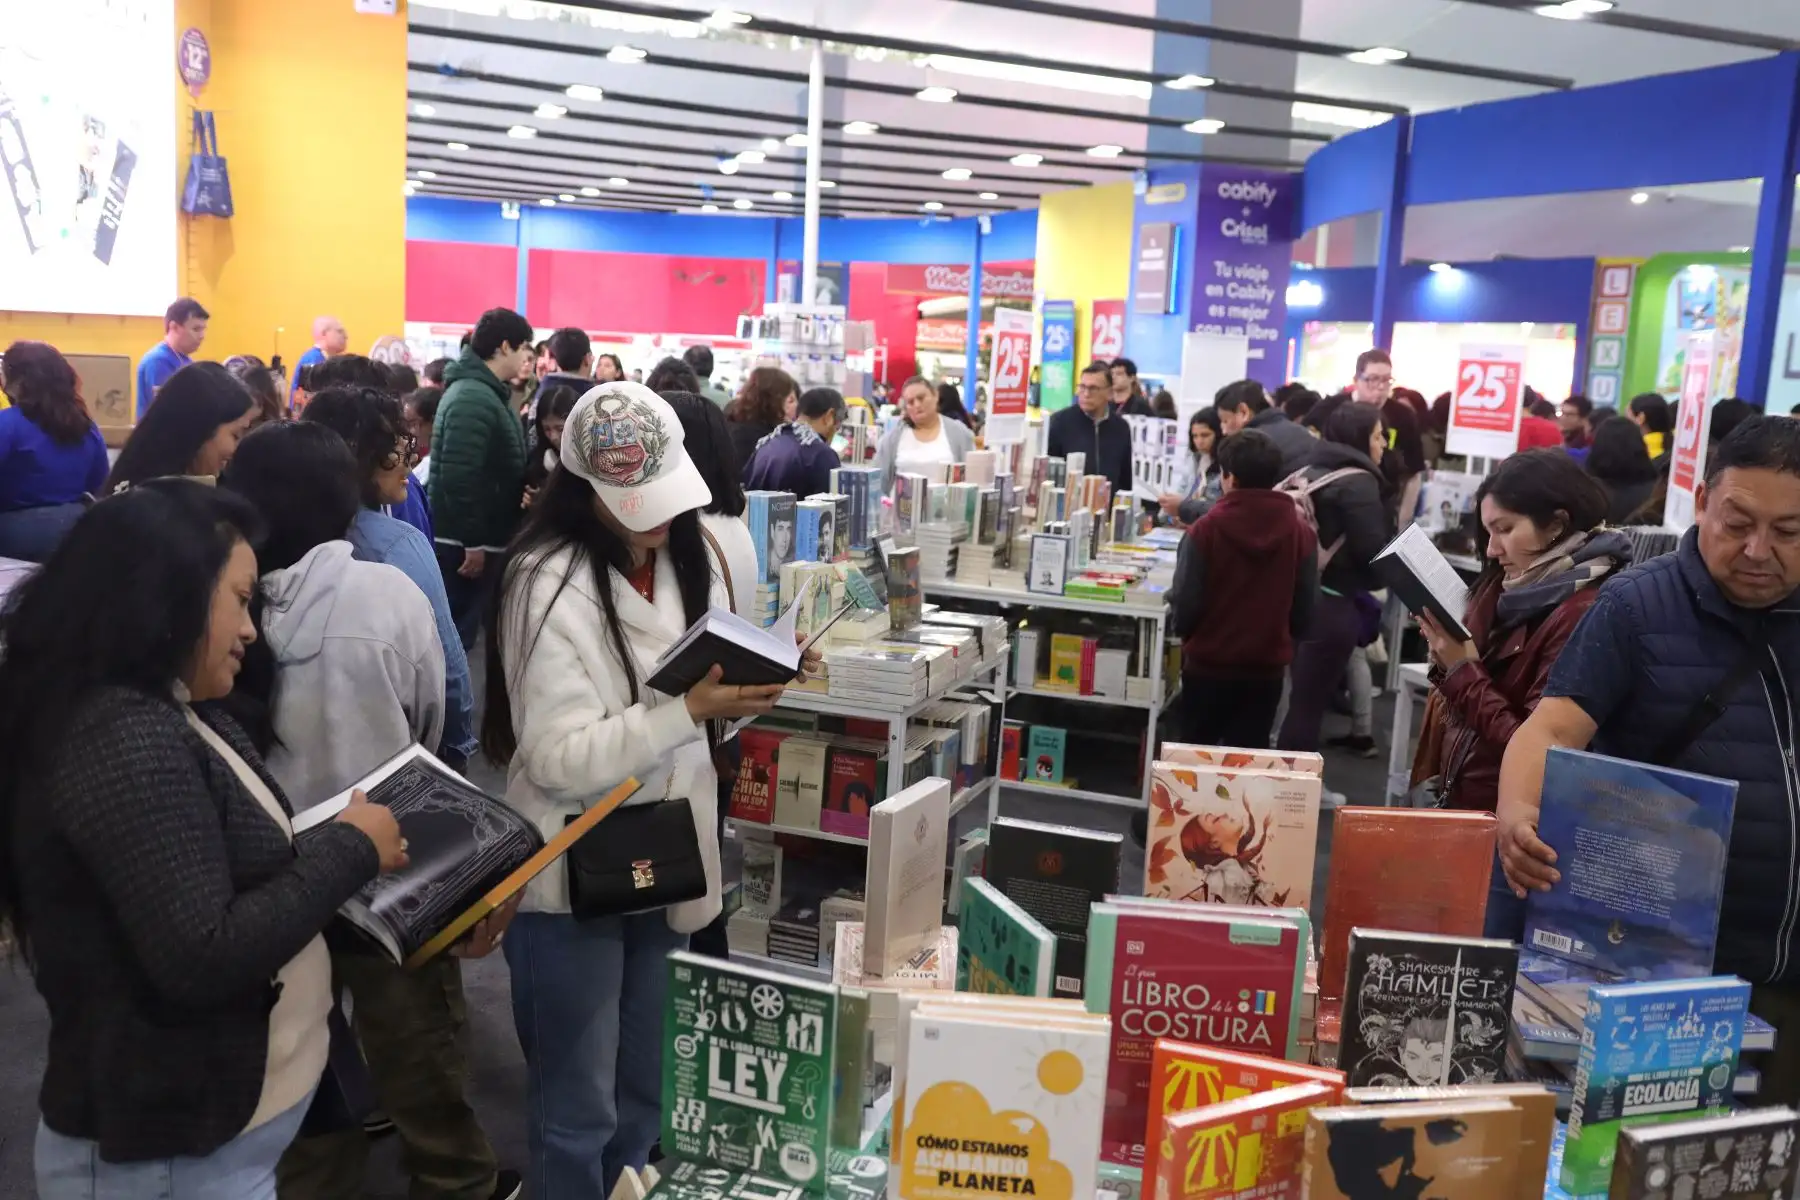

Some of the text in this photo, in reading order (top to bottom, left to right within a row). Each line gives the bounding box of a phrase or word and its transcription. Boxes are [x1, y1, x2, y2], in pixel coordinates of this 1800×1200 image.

[1218, 180, 1278, 207] cabify
[1214, 260, 1269, 283] Tu viaje
[1205, 281, 1275, 303] en Cabify
[1208, 303, 1269, 321] es mejor
[1095, 314, 1123, 357] 25
[1247, 321, 1278, 341] libro
[996, 336, 1024, 389] 25
[1458, 363, 1507, 410] 25
[1400, 961, 1480, 977] SHAKESPEARE
[1122, 980, 1210, 1010] LIBRO
[1378, 970, 1495, 999] HAMLET
[1120, 1008, 1272, 1046] COSTURA
[709, 1046, 787, 1104] LEY
[1624, 1077, 1700, 1106] ECOLOGÍA
[916, 1134, 1029, 1158] CÓMO ESTAMOS
[915, 1150, 1029, 1177] ACABANDO
[938, 1170, 1036, 1197] PLANETA
